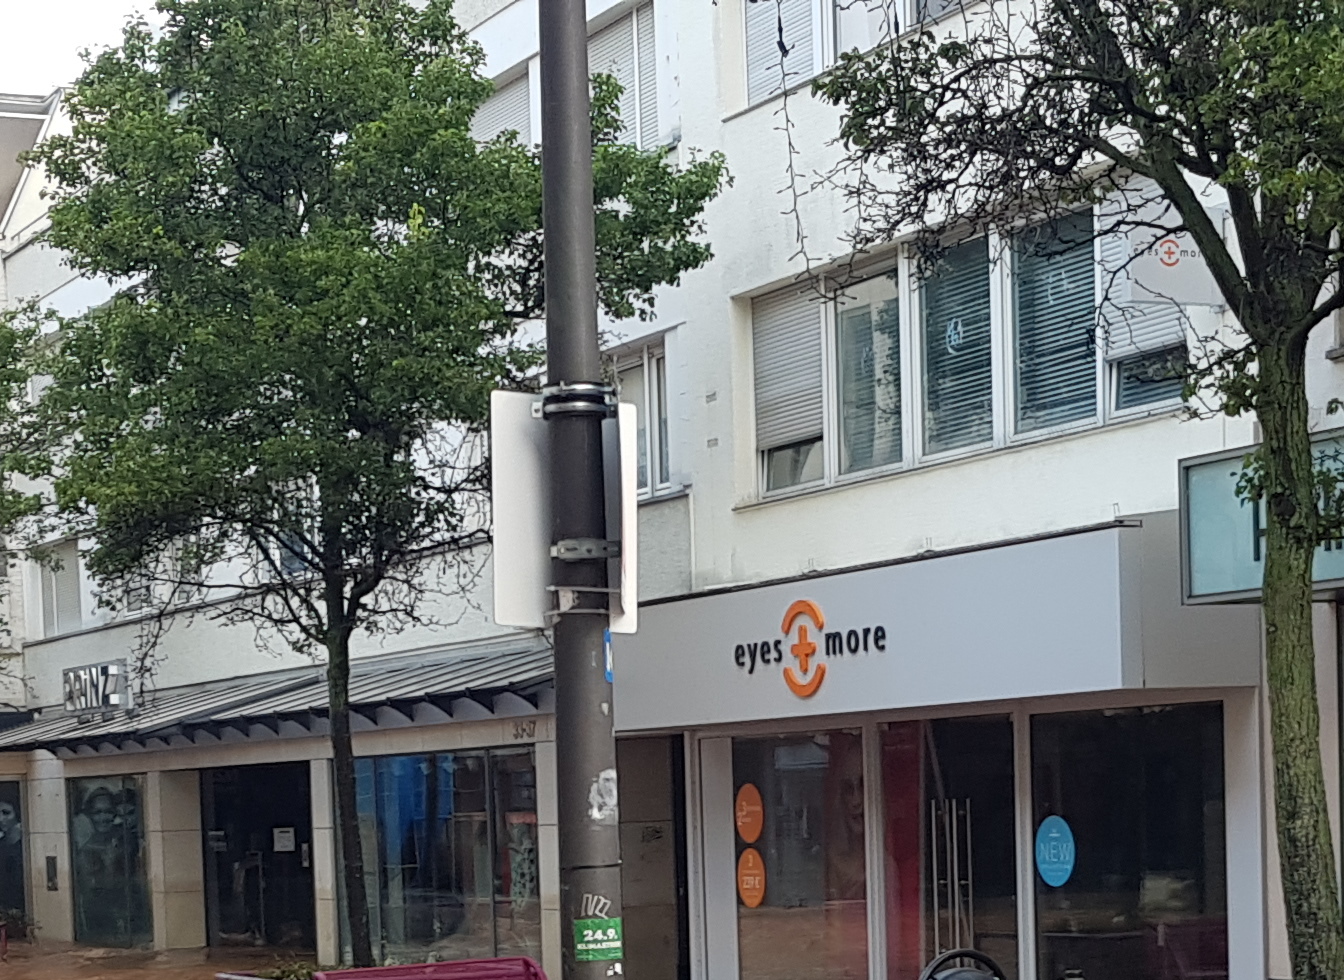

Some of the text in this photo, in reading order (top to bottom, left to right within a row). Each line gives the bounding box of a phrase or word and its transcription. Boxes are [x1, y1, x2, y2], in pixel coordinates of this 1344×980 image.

[734, 625, 886, 675] eyes more
[1040, 841, 1072, 861] NEW
[583, 928, 618, 941] 24.9.
